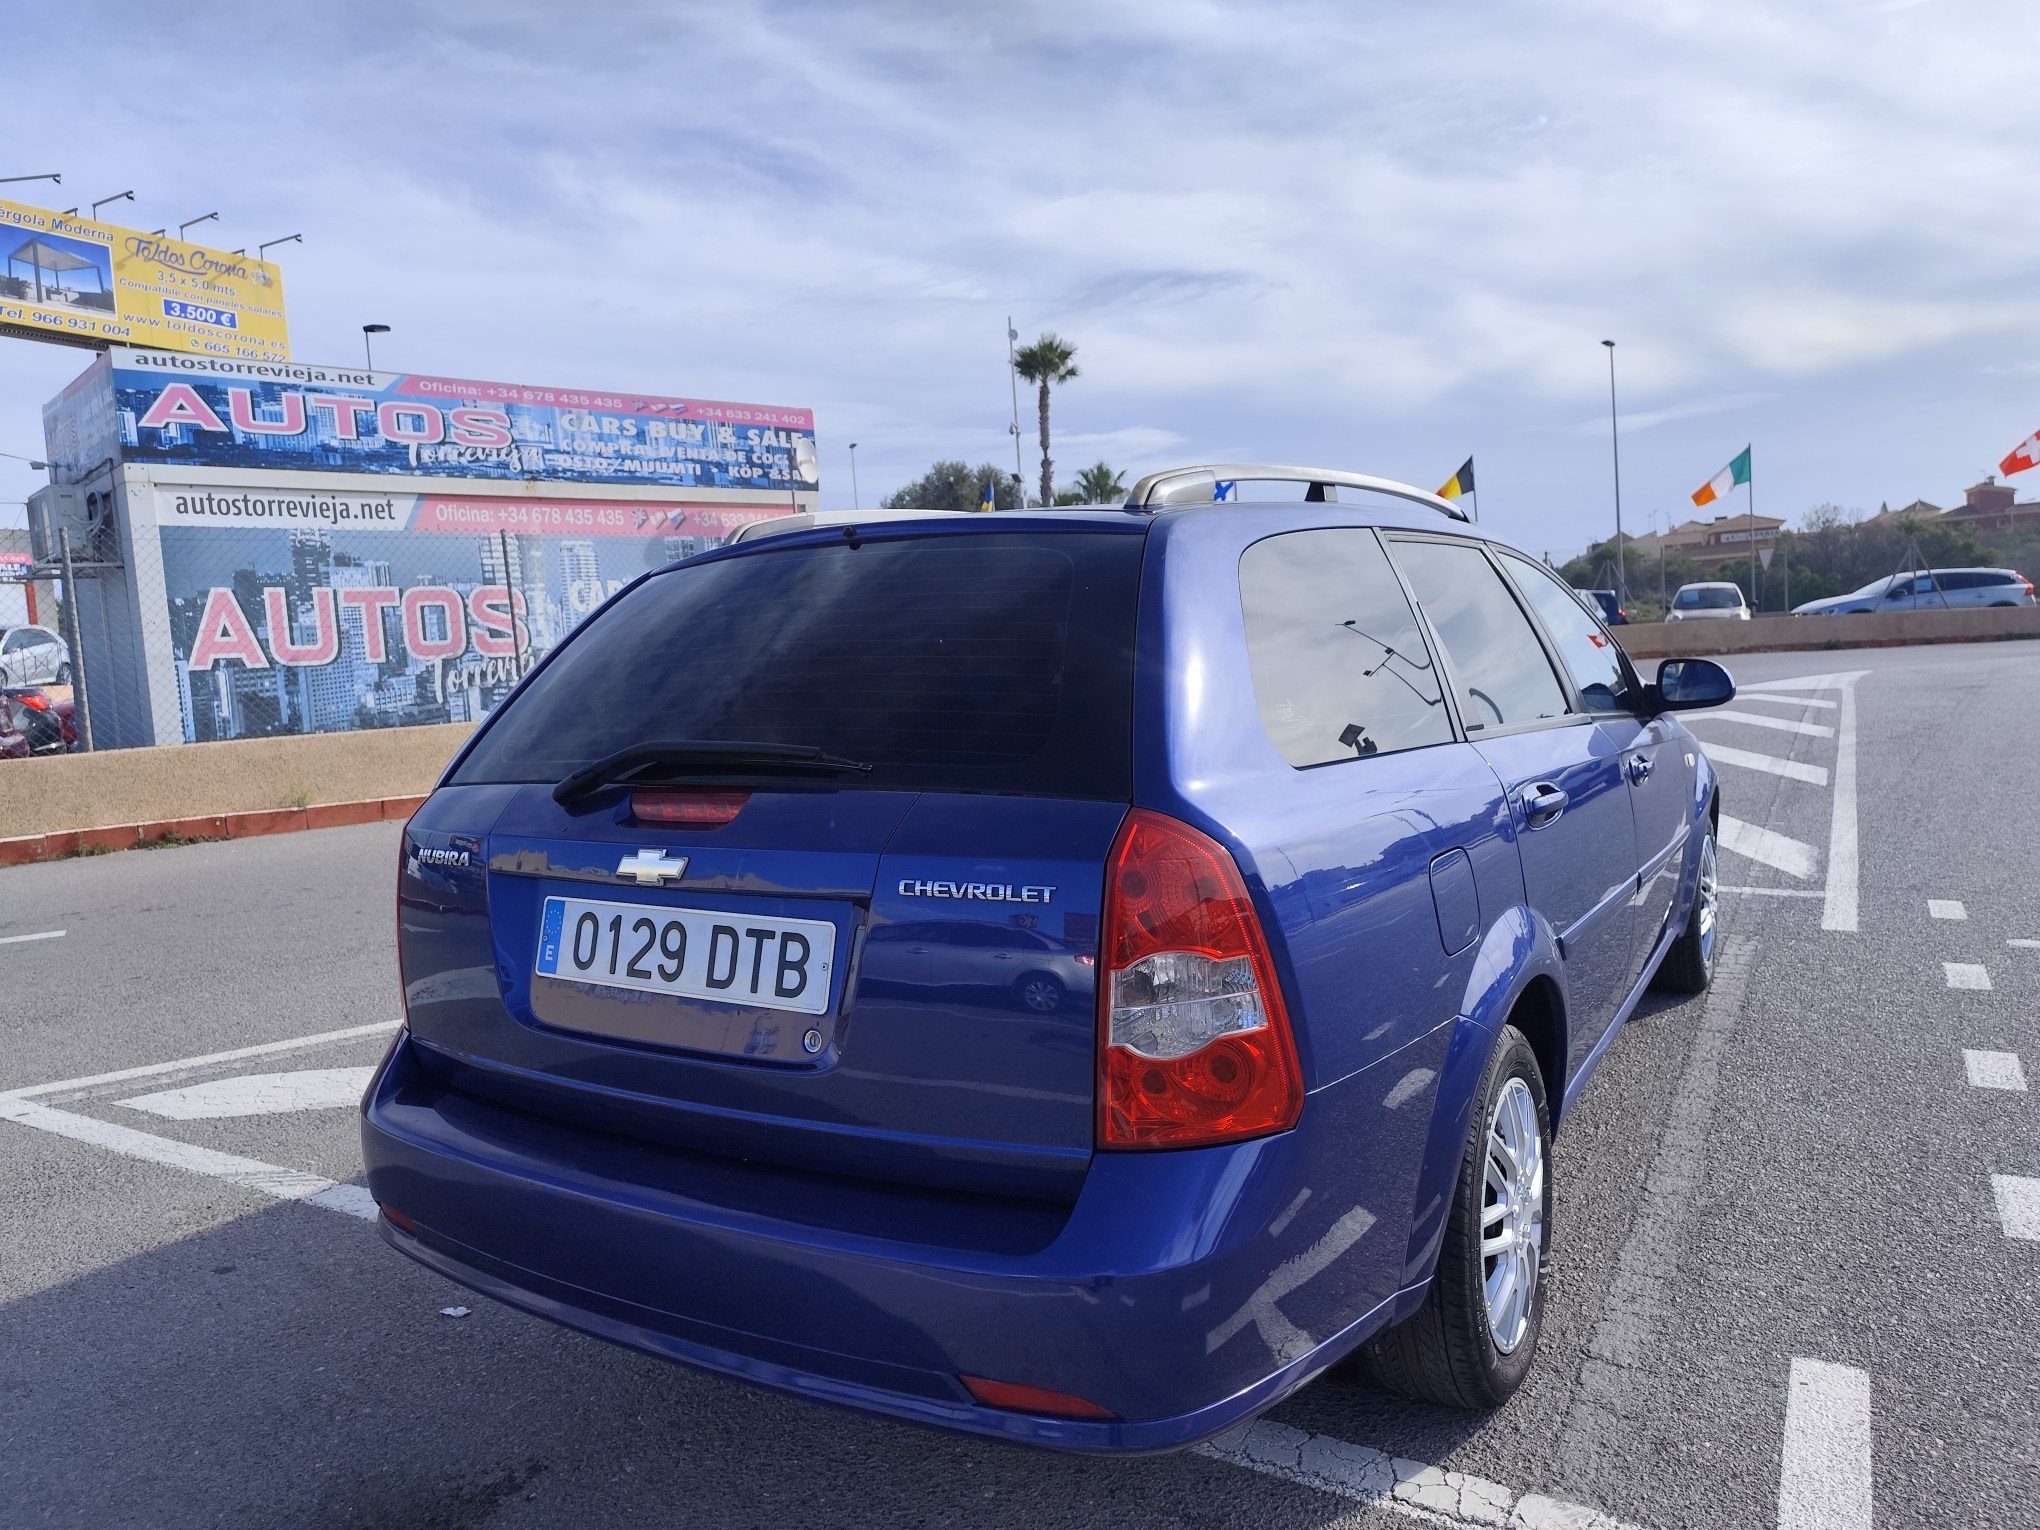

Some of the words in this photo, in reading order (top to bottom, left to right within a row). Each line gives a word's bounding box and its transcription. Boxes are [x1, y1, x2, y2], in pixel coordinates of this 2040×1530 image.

[52, 218, 114, 241] Moderna
[125, 237, 196, 272] Toldos
[190, 251, 248, 280] Corona
[119, 277, 181, 297] Compatible
[184, 291, 203, 301] con
[206, 297, 245, 310] paneles
[32, 312, 63, 326] 966
[68, 318, 96, 331] 931
[102, 322, 131, 337] 004
[170, 302, 217, 324] 3.500
[220, 313, 232, 327] €
[123, 313, 287, 350] www.toldoscorona.es
[204, 341, 230, 354] 665
[236, 346, 259, 359] 166
[263, 352, 287, 363] 572
[135, 353, 376, 386] autostorrevieja.net
[419, 380, 482, 396] Oficina:
[487, 384, 519, 399] +34
[524, 390, 555, 402] 678
[559, 394, 589, 406] 435
[593, 397, 623, 408] 435
[138, 382, 513, 449] AUTOS
[561, 413, 638, 436] CARS
[649, 420, 706, 441] BUY
[697, 407, 723, 418] +34
[726, 408, 752, 419] 633
[754, 411, 778, 422] 241
[781, 414, 805, 425] 402
[724, 450, 747, 463] DE
[175, 493, 397, 524] autostorrevieja.net
[436, 504, 494, 523] Oficina:
[498, 507, 529, 523] +34
[532, 508, 561, 524] 678
[565, 508, 593, 525] 435
[597, 510, 625, 526] 435
[693, 511, 718, 527] +34
[188, 585, 531, 671] AUTOS
[417, 847, 470, 867] NUBIRA
[898, 879, 1057, 904] CHEVROLET
[545, 944, 554, 961] E
[573, 911, 688, 983] 0129
[705, 924, 811, 999] DTB
